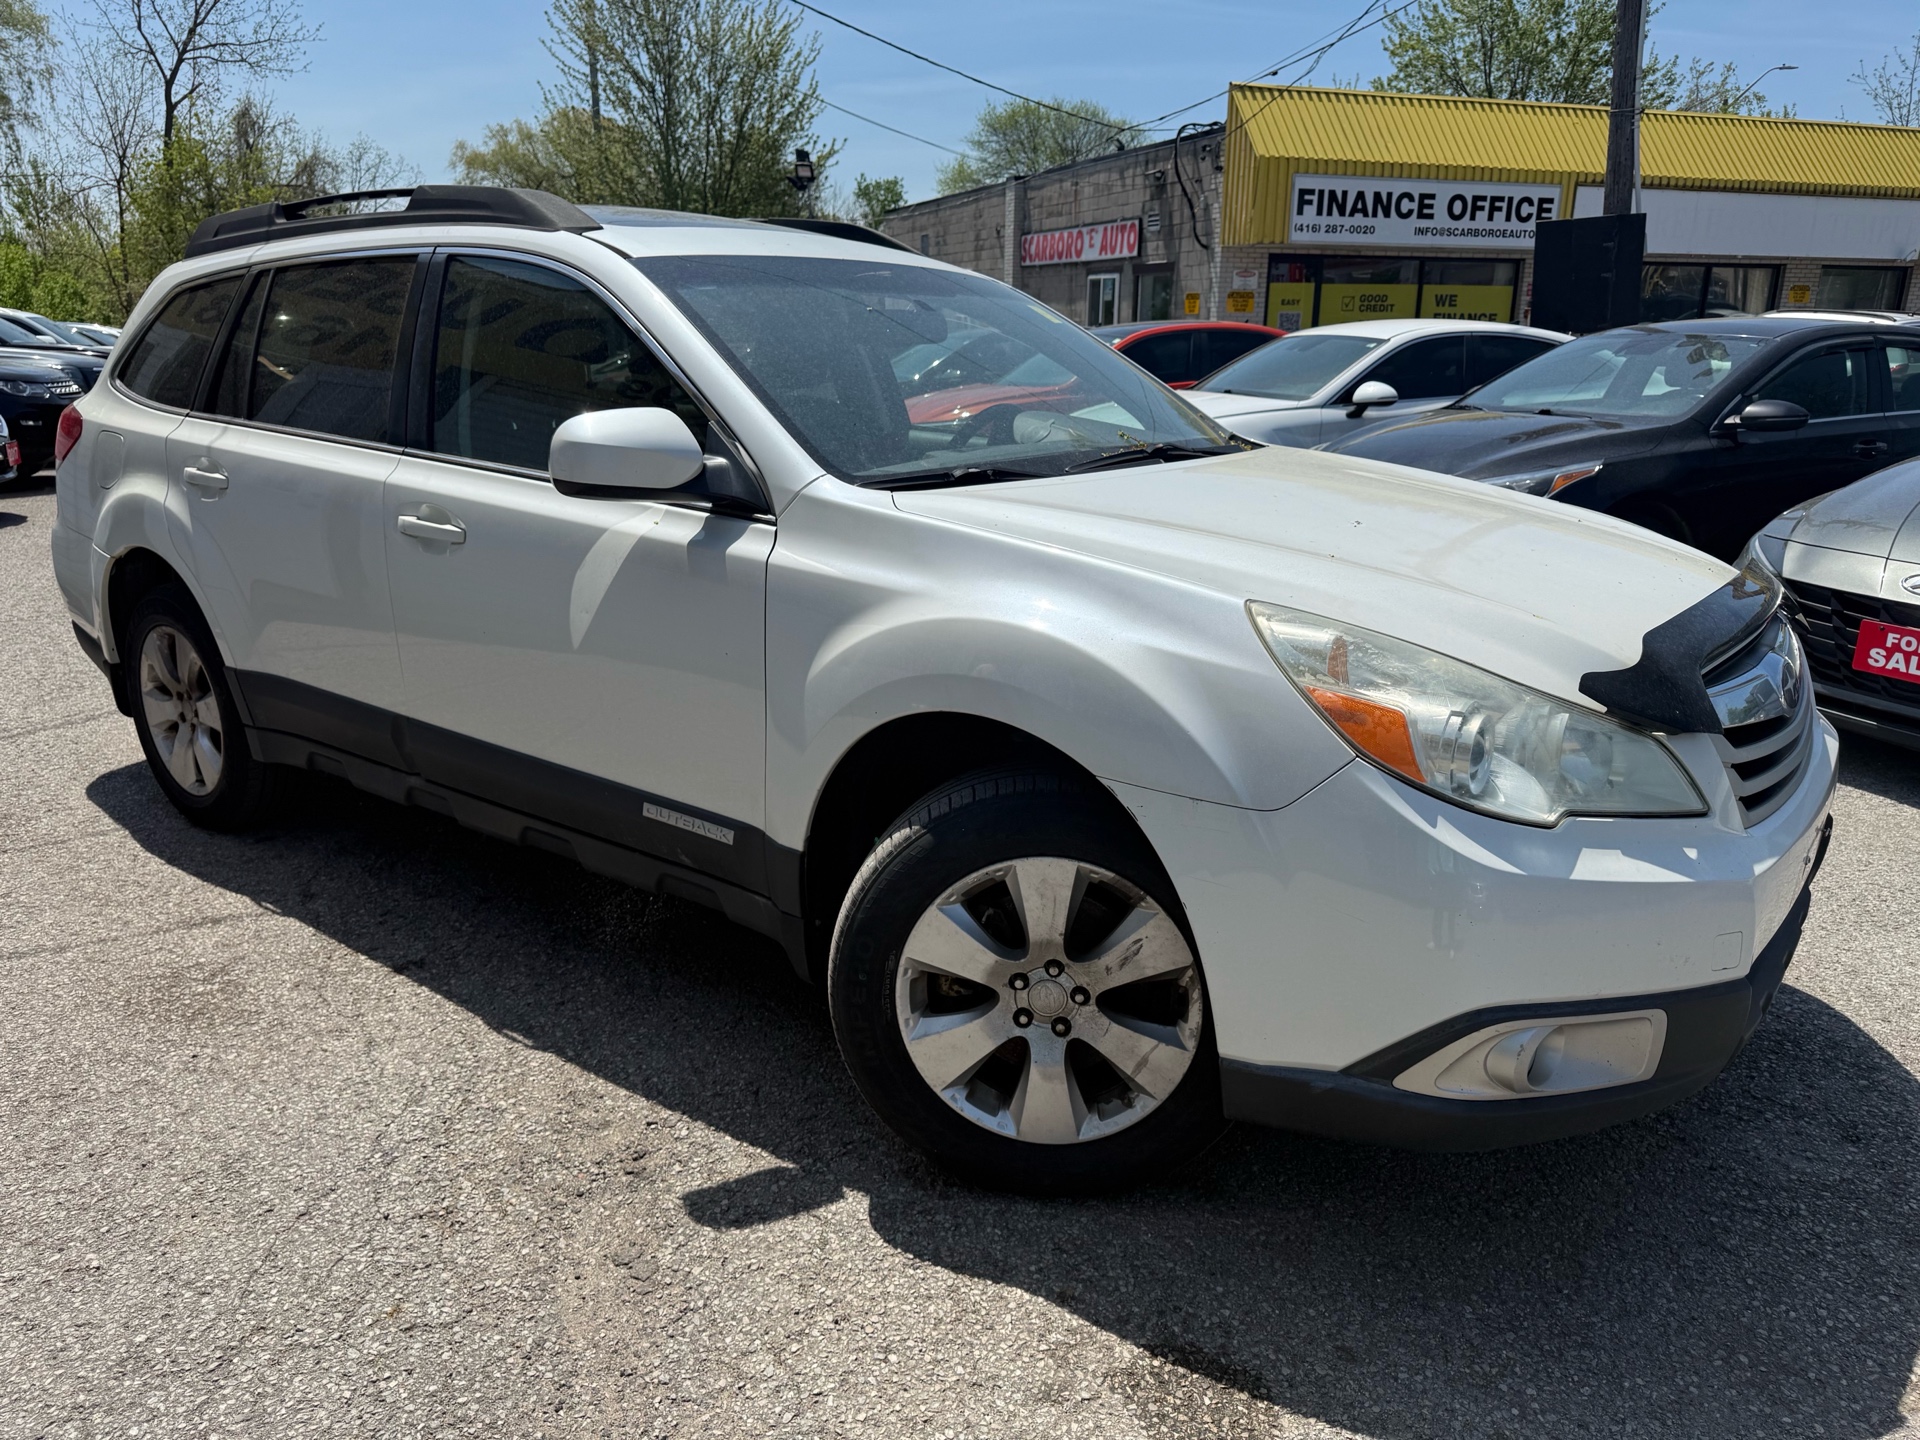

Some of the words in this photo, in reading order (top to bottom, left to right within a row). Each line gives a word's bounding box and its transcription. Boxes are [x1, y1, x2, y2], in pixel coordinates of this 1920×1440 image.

[1296, 188, 1436, 220] FINANCE
[1447, 193, 1555, 224] OFFICE
[1294, 223, 1321, 233] (416)
[1324, 224, 1376, 235] 287-0020
[1414, 226, 1536, 239] INFO@SCARBOROEAUTO
[1022, 229, 1085, 263] SCARBORO
[1098, 222, 1137, 256] AUTO
[1359, 294, 1388, 303] GOOD
[1435, 294, 1458, 307] WE
[1358, 304, 1395, 313] CREDIT
[1885, 632, 1920, 653] FO
[646, 807, 731, 842] OUTBACK
